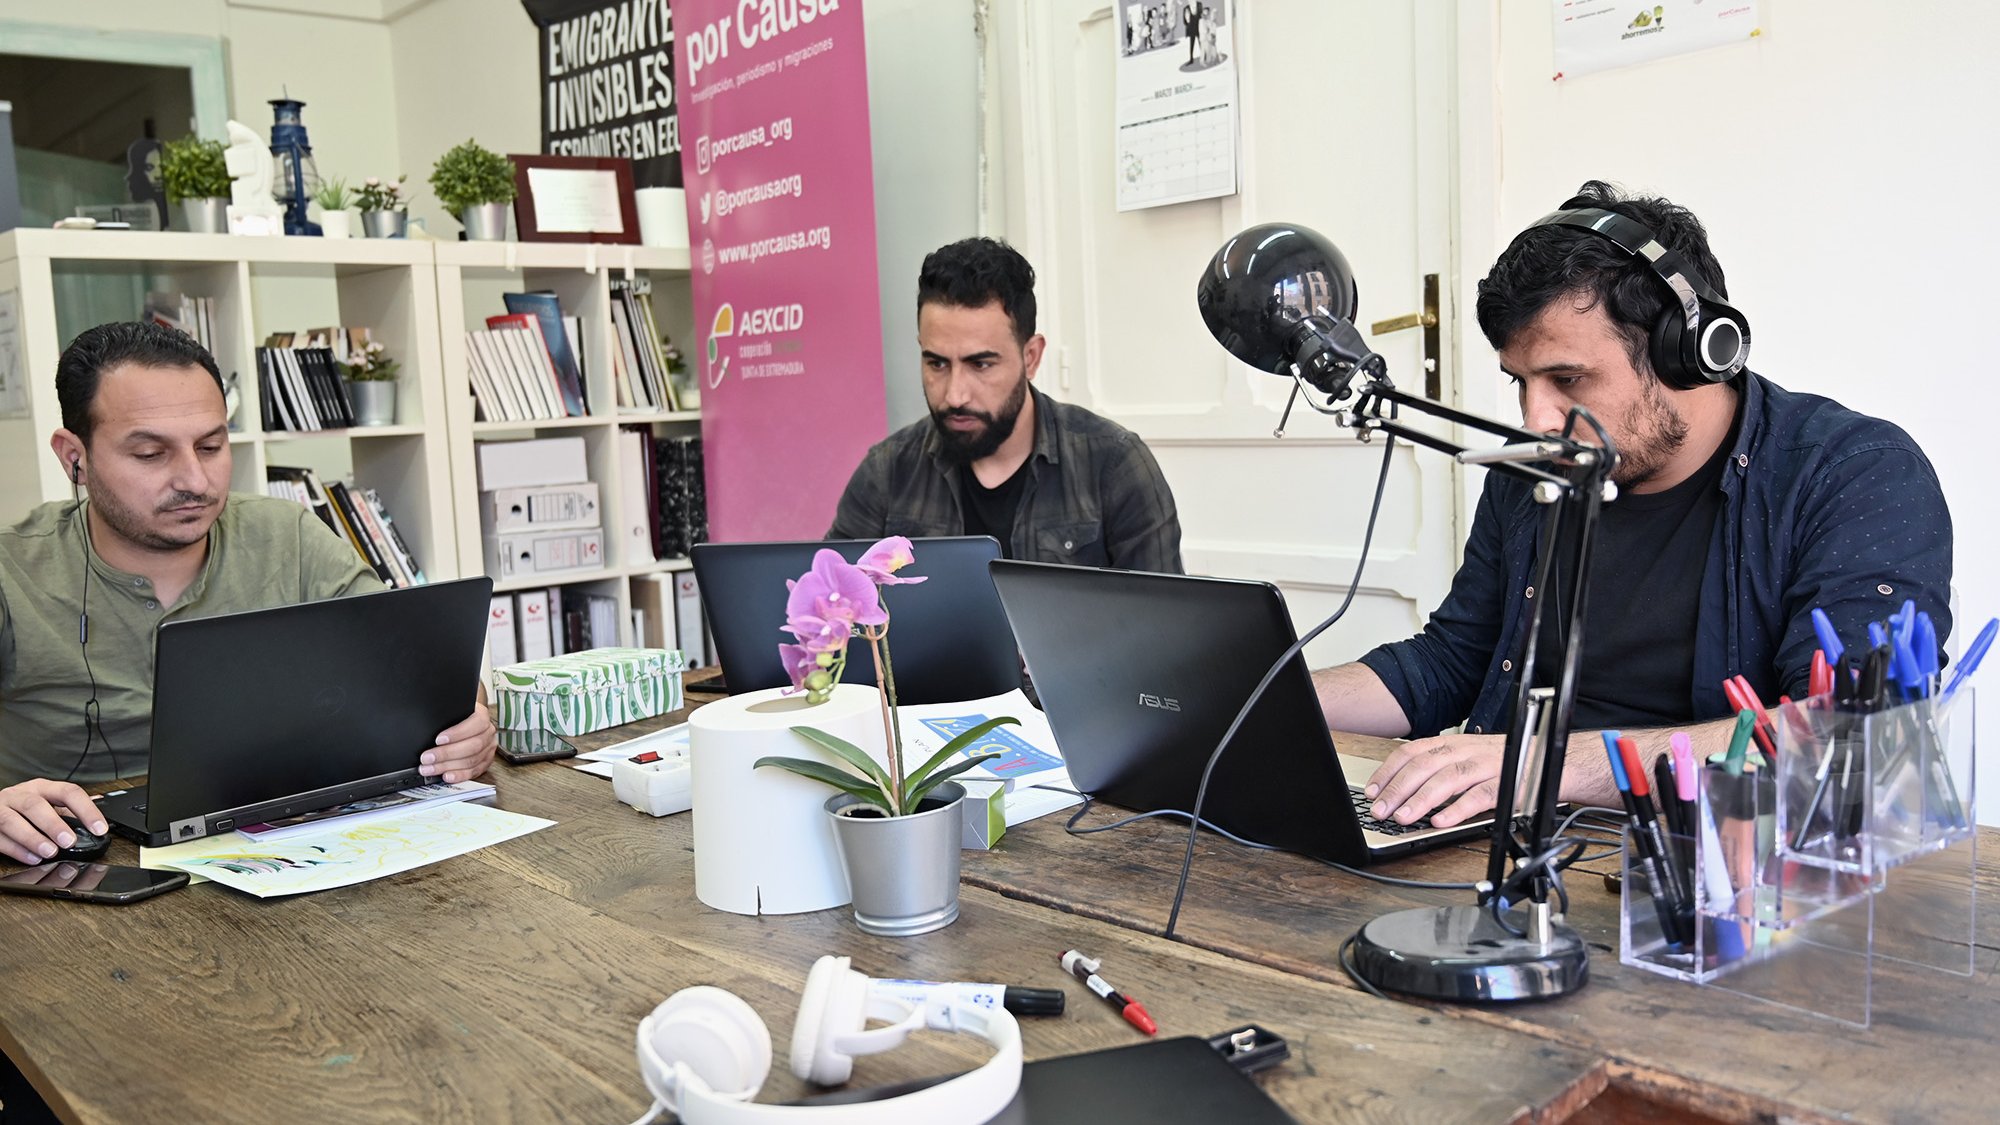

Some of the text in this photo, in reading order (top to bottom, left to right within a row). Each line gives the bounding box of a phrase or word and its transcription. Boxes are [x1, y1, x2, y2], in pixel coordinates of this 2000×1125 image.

[549, 0, 674, 76] EMIGRANTE
[686, 16, 731, 86] por
[777, 58, 784, 73] y
[784, 37, 833, 67] migraciones
[549, 51, 672, 132] INVISIBLES
[633, 120, 655, 160] EN
[711, 116, 793, 160] porcausa_org
[715, 174, 802, 216] @porcausaorg
[718, 226, 831, 264] www.porcausa.org
[738, 303, 804, 336] AEXCID
[1138, 693, 1181, 712] ASUS
